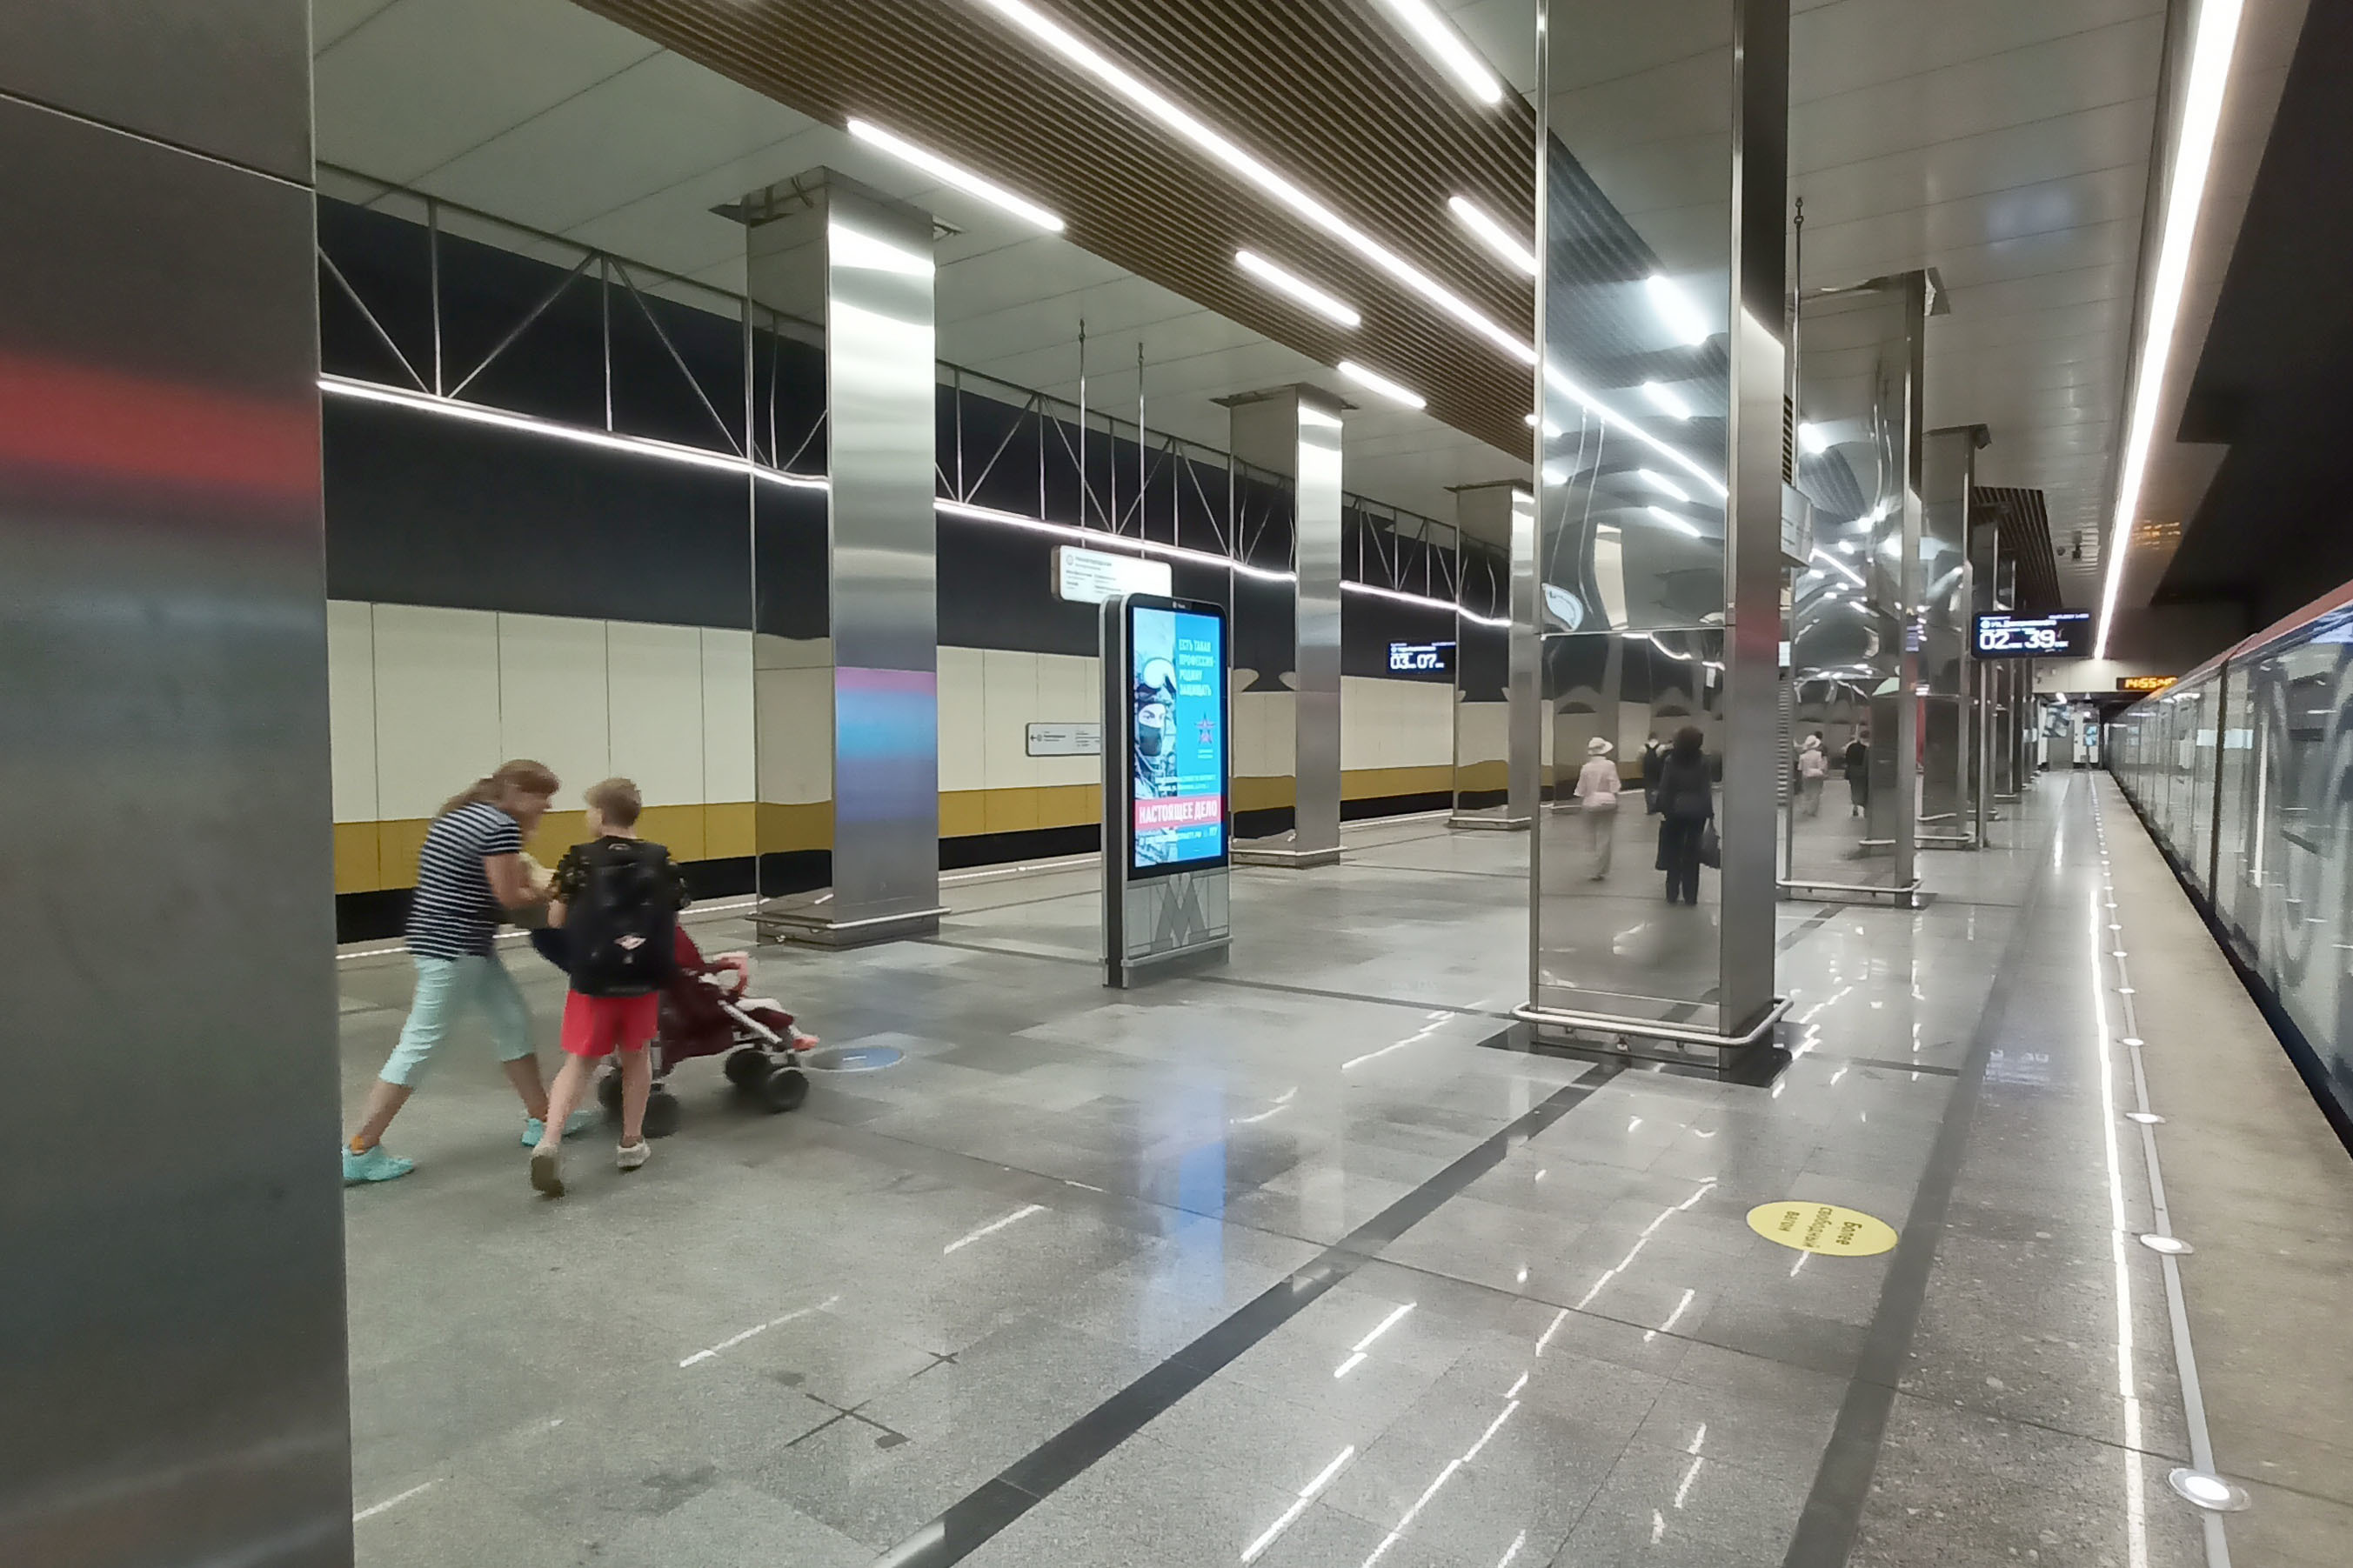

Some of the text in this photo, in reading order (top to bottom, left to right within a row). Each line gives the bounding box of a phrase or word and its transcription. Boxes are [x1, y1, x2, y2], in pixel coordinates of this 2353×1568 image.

[1980, 630, 2056, 650] 02 39
[1416, 653, 1437, 669] 07
[1139, 800, 1218, 824] НАСТОЯЩЕЕ ДЕЛО
[1835, 1222, 1862, 1245] Более
